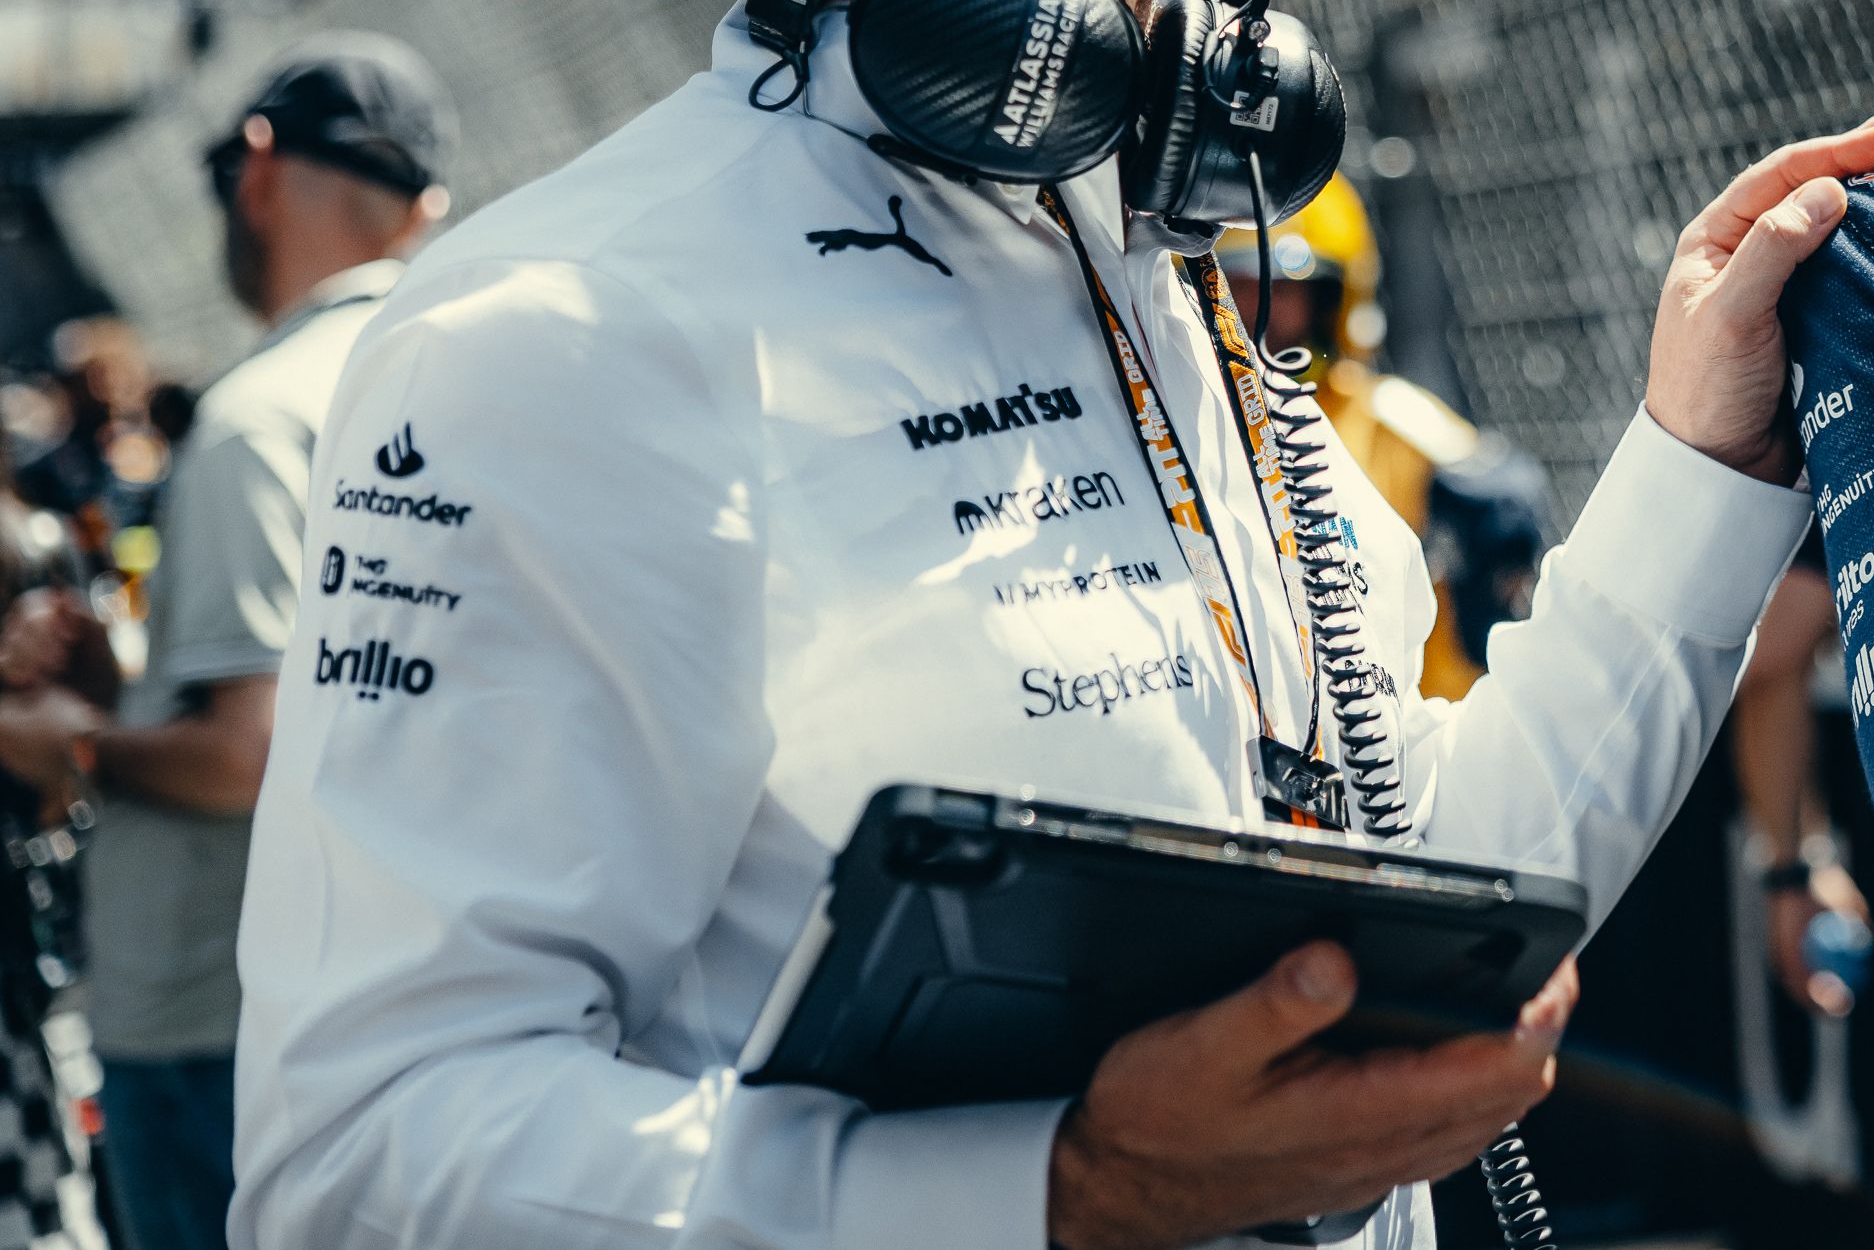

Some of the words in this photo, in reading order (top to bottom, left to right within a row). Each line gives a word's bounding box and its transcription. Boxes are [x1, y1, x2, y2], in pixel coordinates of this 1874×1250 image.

[1016, 57, 1065, 147] WILLIAMS
[1114, 330, 1144, 384] GRID
[901, 383, 1083, 451] KOMATSU
[1237, 374, 1266, 426] GRID
[1800, 383, 1854, 455] ander
[333, 478, 472, 528] Santander
[1147, 443, 1196, 509] PIT
[316, 637, 435, 701] brillio
[1021, 652, 1194, 719] Stephens
